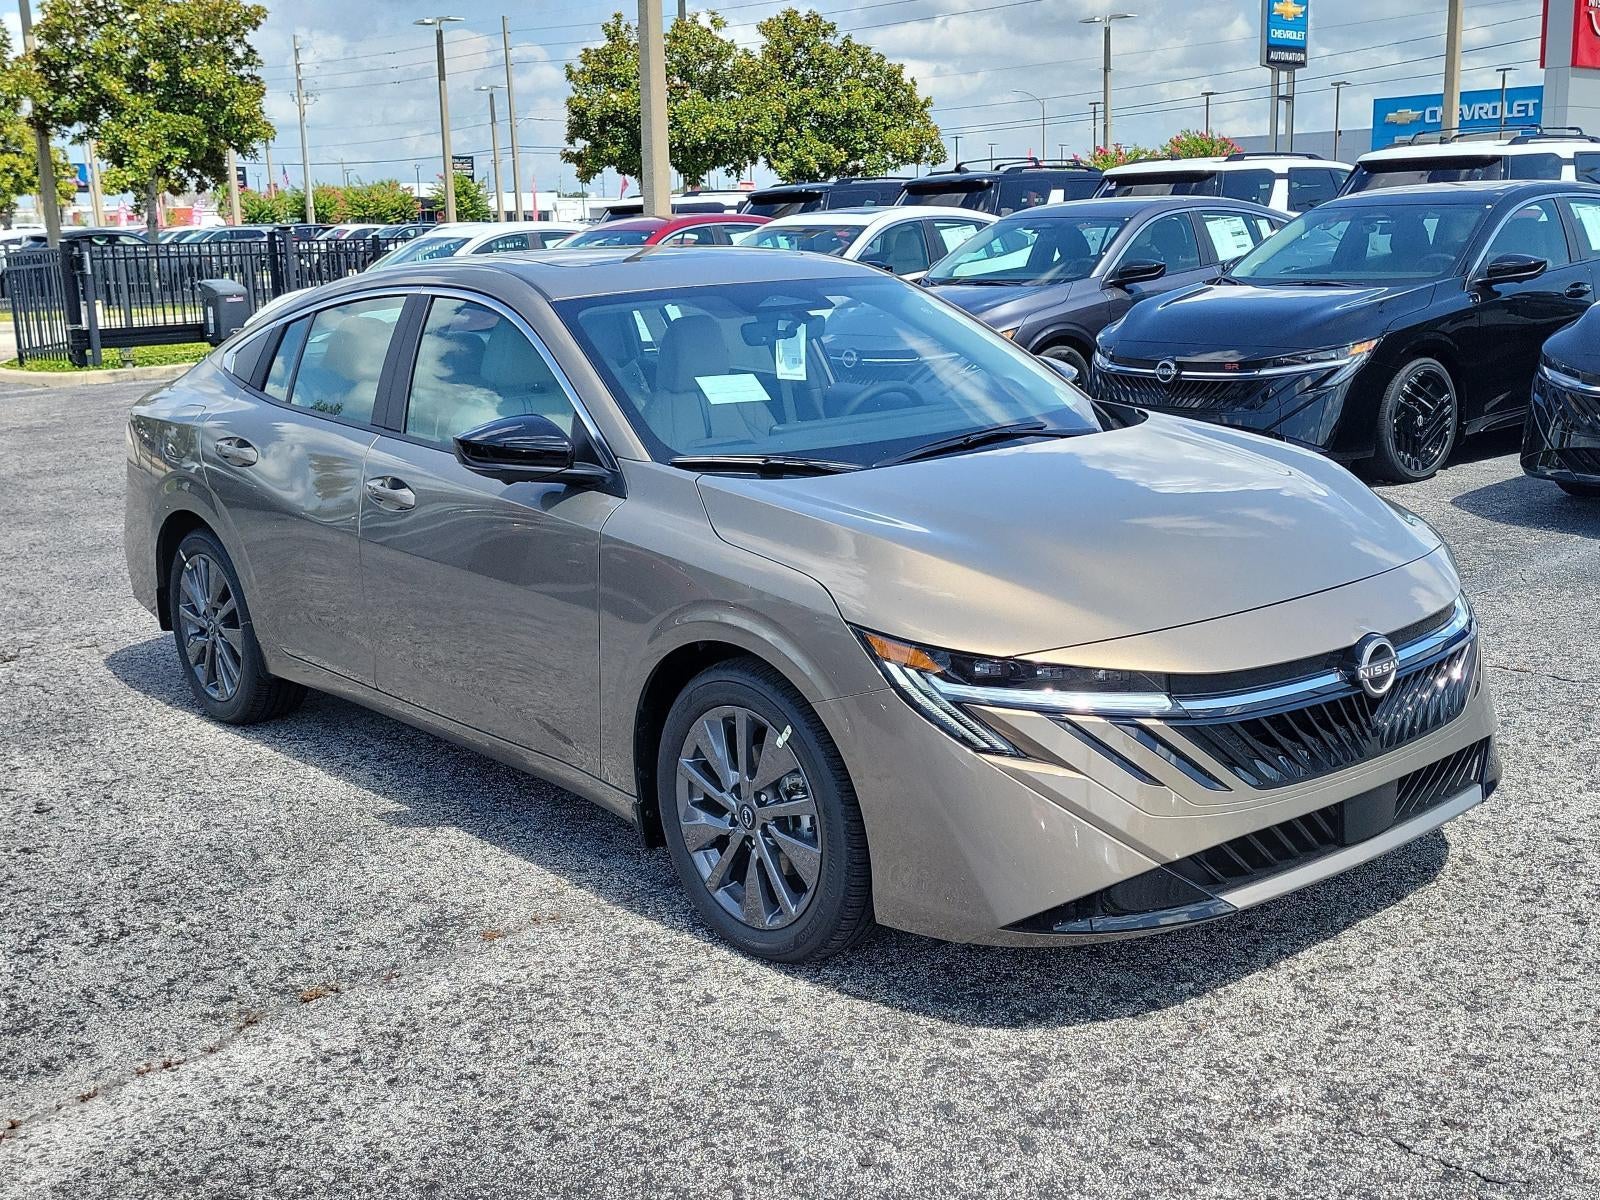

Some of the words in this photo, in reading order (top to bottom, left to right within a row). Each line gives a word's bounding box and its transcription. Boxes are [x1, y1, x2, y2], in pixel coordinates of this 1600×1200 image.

[1271, 29, 1306, 41] CHEVROLET
[1270, 51, 1305, 61] AUTONATION
[1425, 99, 1539, 123] CVROLET
[1360, 659, 1400, 679] NISSAN
